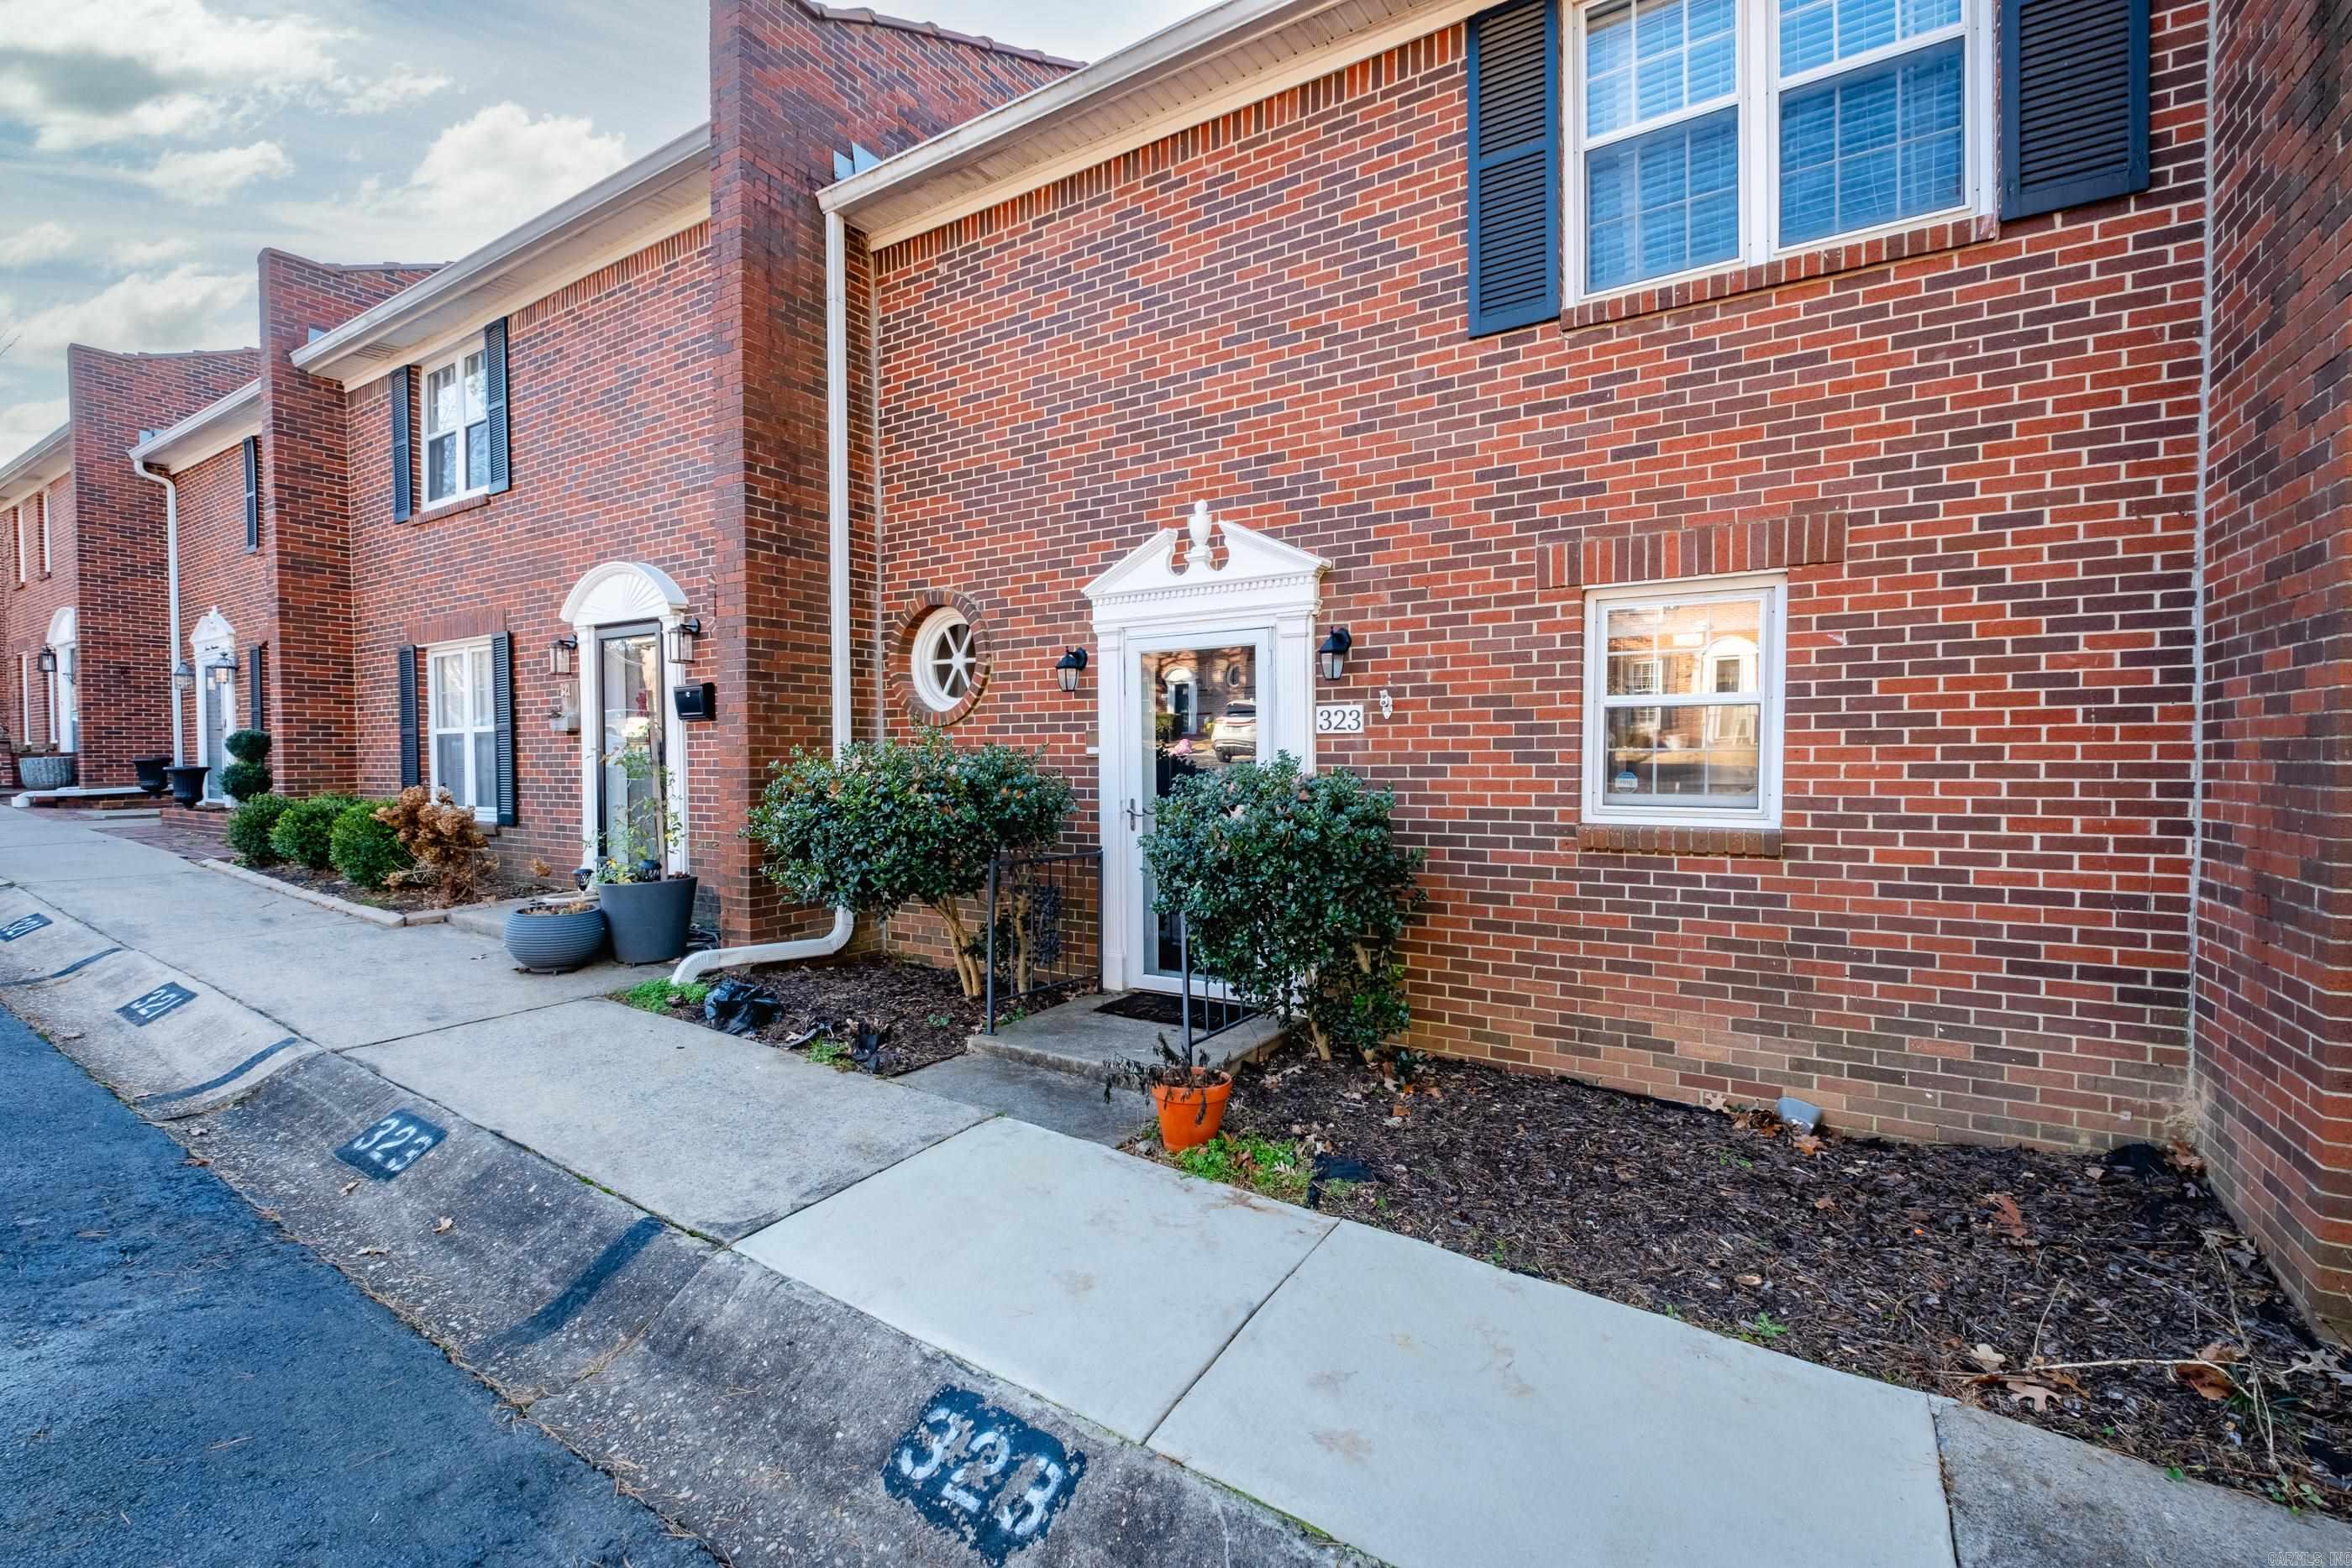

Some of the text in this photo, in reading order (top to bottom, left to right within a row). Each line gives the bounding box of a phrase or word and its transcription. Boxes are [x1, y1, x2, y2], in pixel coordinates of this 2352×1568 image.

[1319, 710, 1361, 731] 323
[130, 989, 182, 1019] 321
[354, 1118, 433, 1172] 323
[898, 1408, 1064, 1537] 323
